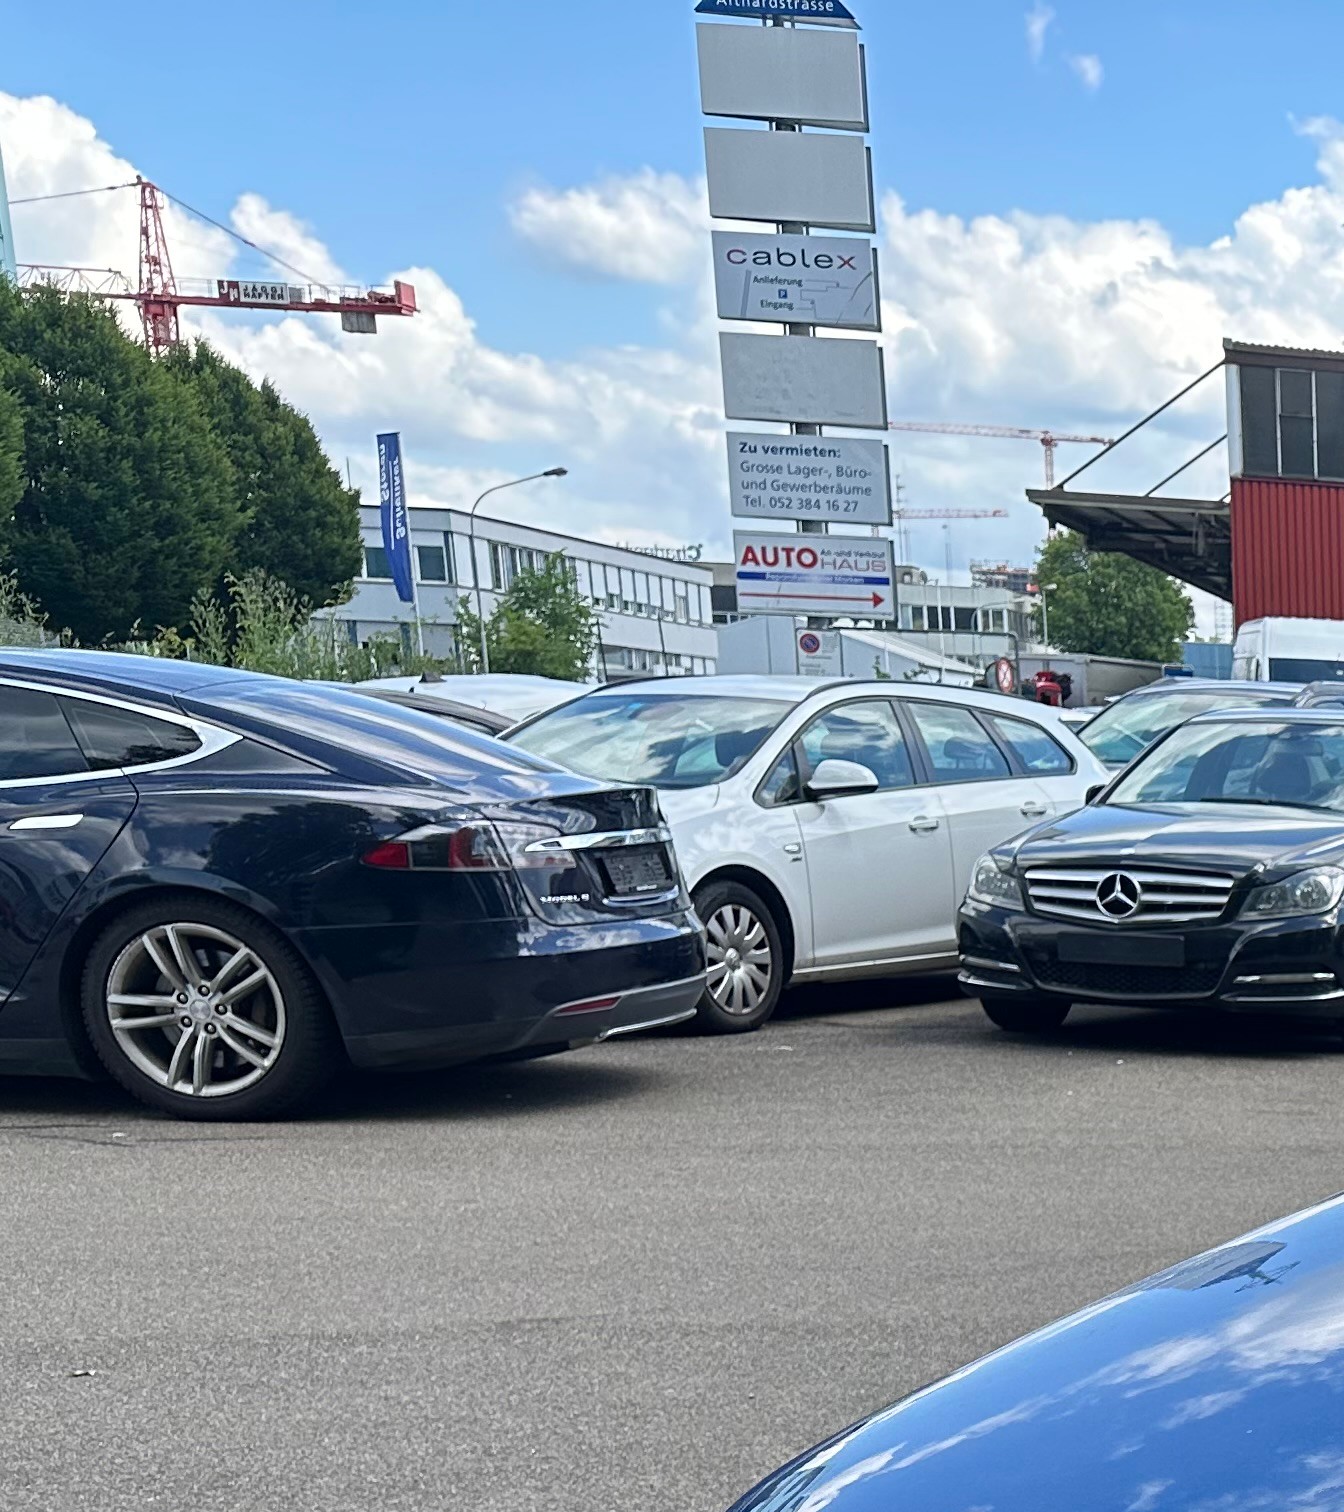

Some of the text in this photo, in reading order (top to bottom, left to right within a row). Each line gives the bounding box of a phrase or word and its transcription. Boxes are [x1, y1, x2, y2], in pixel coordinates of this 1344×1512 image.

[726, 247, 857, 270] cablex
[753, 275, 803, 287] Anlieferung
[760, 299, 794, 311] Eingang
[739, 442, 841, 458] Zu vermieten:
[740, 460, 872, 479] Grosse Lager-, Büro-
[741, 478, 872, 496] und Gewerberäume
[743, 495, 859, 513] Tel. 052 384 16 27
[741, 545, 818, 569] AUTO
[820, 558, 887, 573] HAUS
